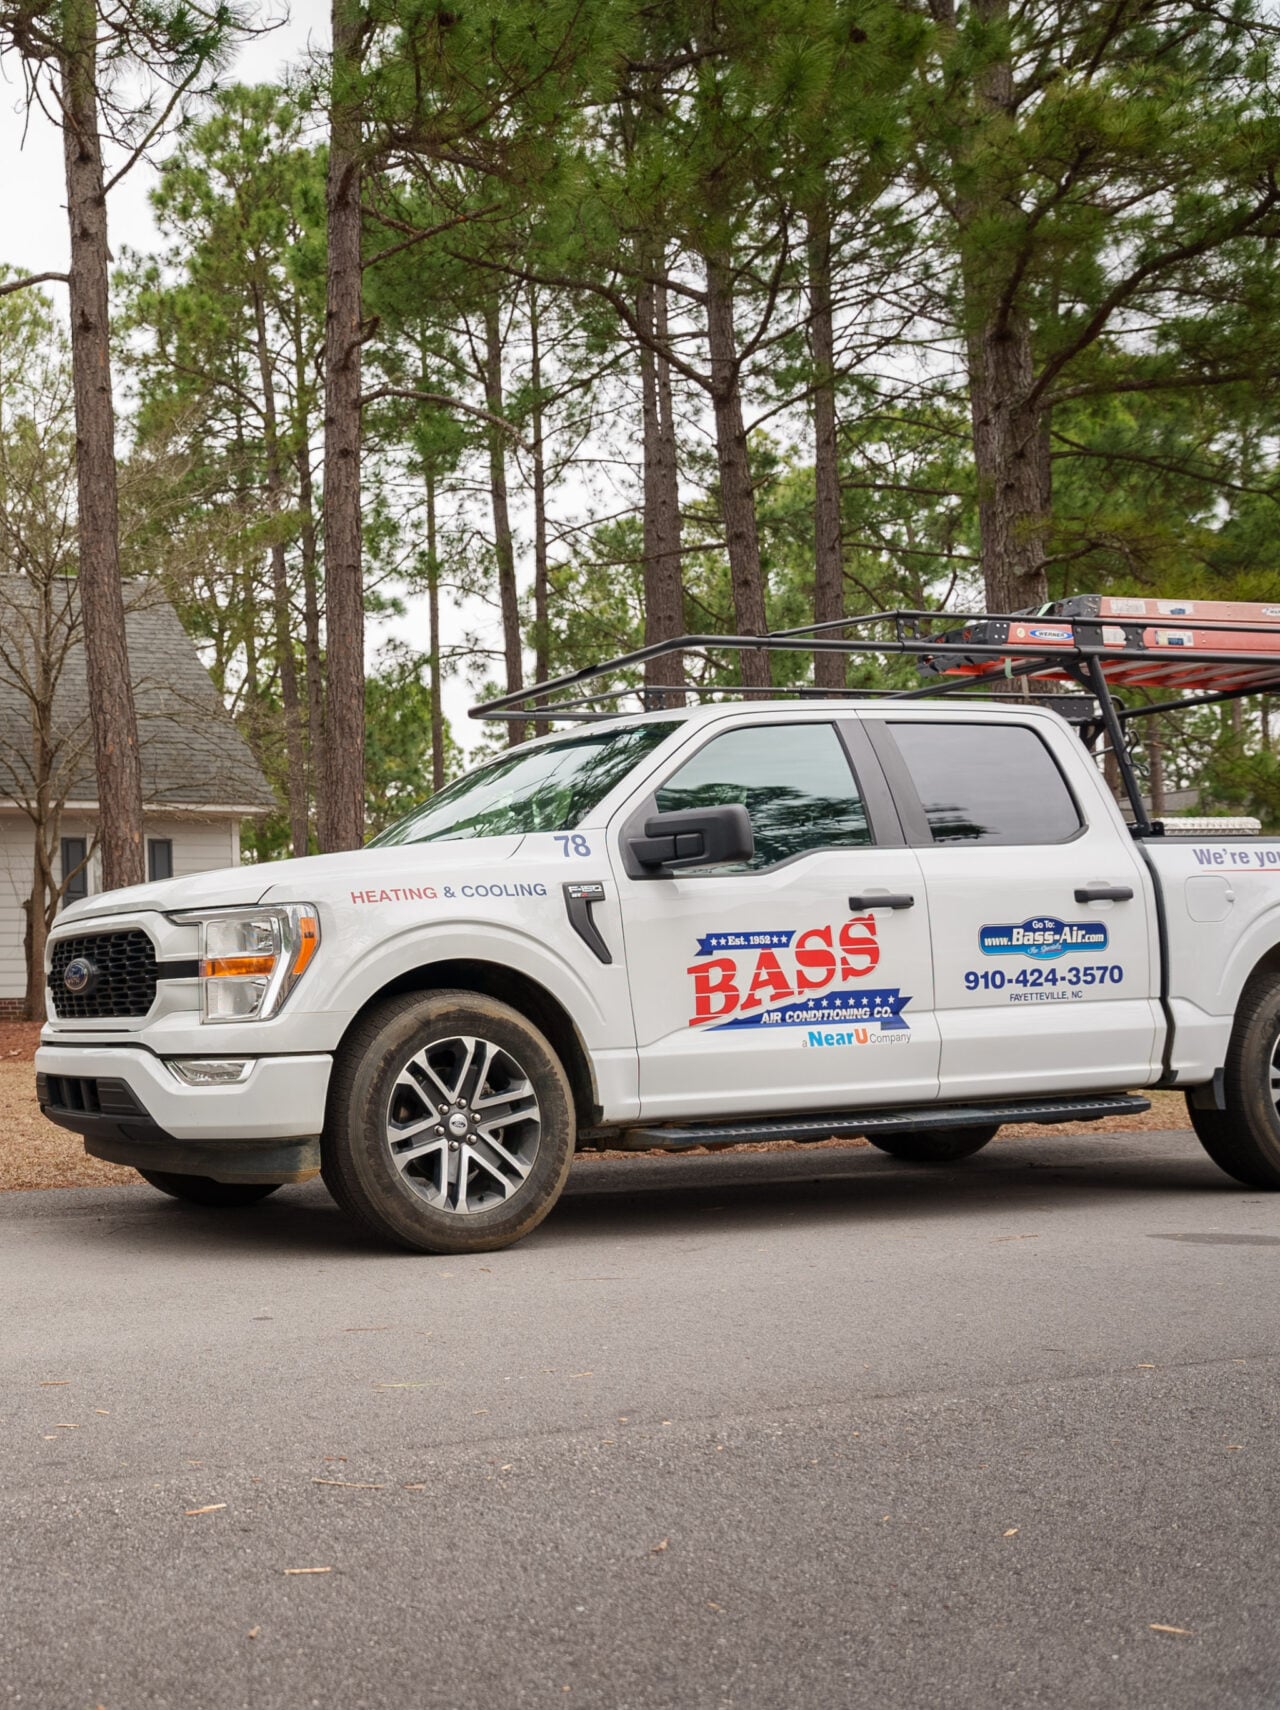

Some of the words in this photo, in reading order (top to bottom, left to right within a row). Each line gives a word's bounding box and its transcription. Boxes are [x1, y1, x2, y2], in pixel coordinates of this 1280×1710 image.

[1038, 630, 1065, 639] WERNER
[553, 834, 592, 858] 78
[1192, 848, 1250, 865] We're
[350, 887, 438, 904] HEATING
[443, 886, 456, 898] &
[461, 883, 547, 898] COOLING
[1032, 920, 1043, 929] Go
[1044, 920, 1055, 929] To:
[727, 935, 748, 946] Est.
[749, 934, 771, 945] 1952
[984, 926, 1105, 946] www.Bass-Air.com
[687, 913, 880, 1026] BASS
[964, 965, 1124, 991] 910-424-3570
[1009, 990, 1069, 1002] FAYETTEVILLE,
[1071, 990, 1083, 999] NC
[760, 1012, 782, 1024] AIR
[785, 1007, 870, 1023] CONDITIONING
[873, 1006, 893, 1018] CO.
[802, 1040, 807, 1048] a
[869, 1032, 911, 1045] Company
